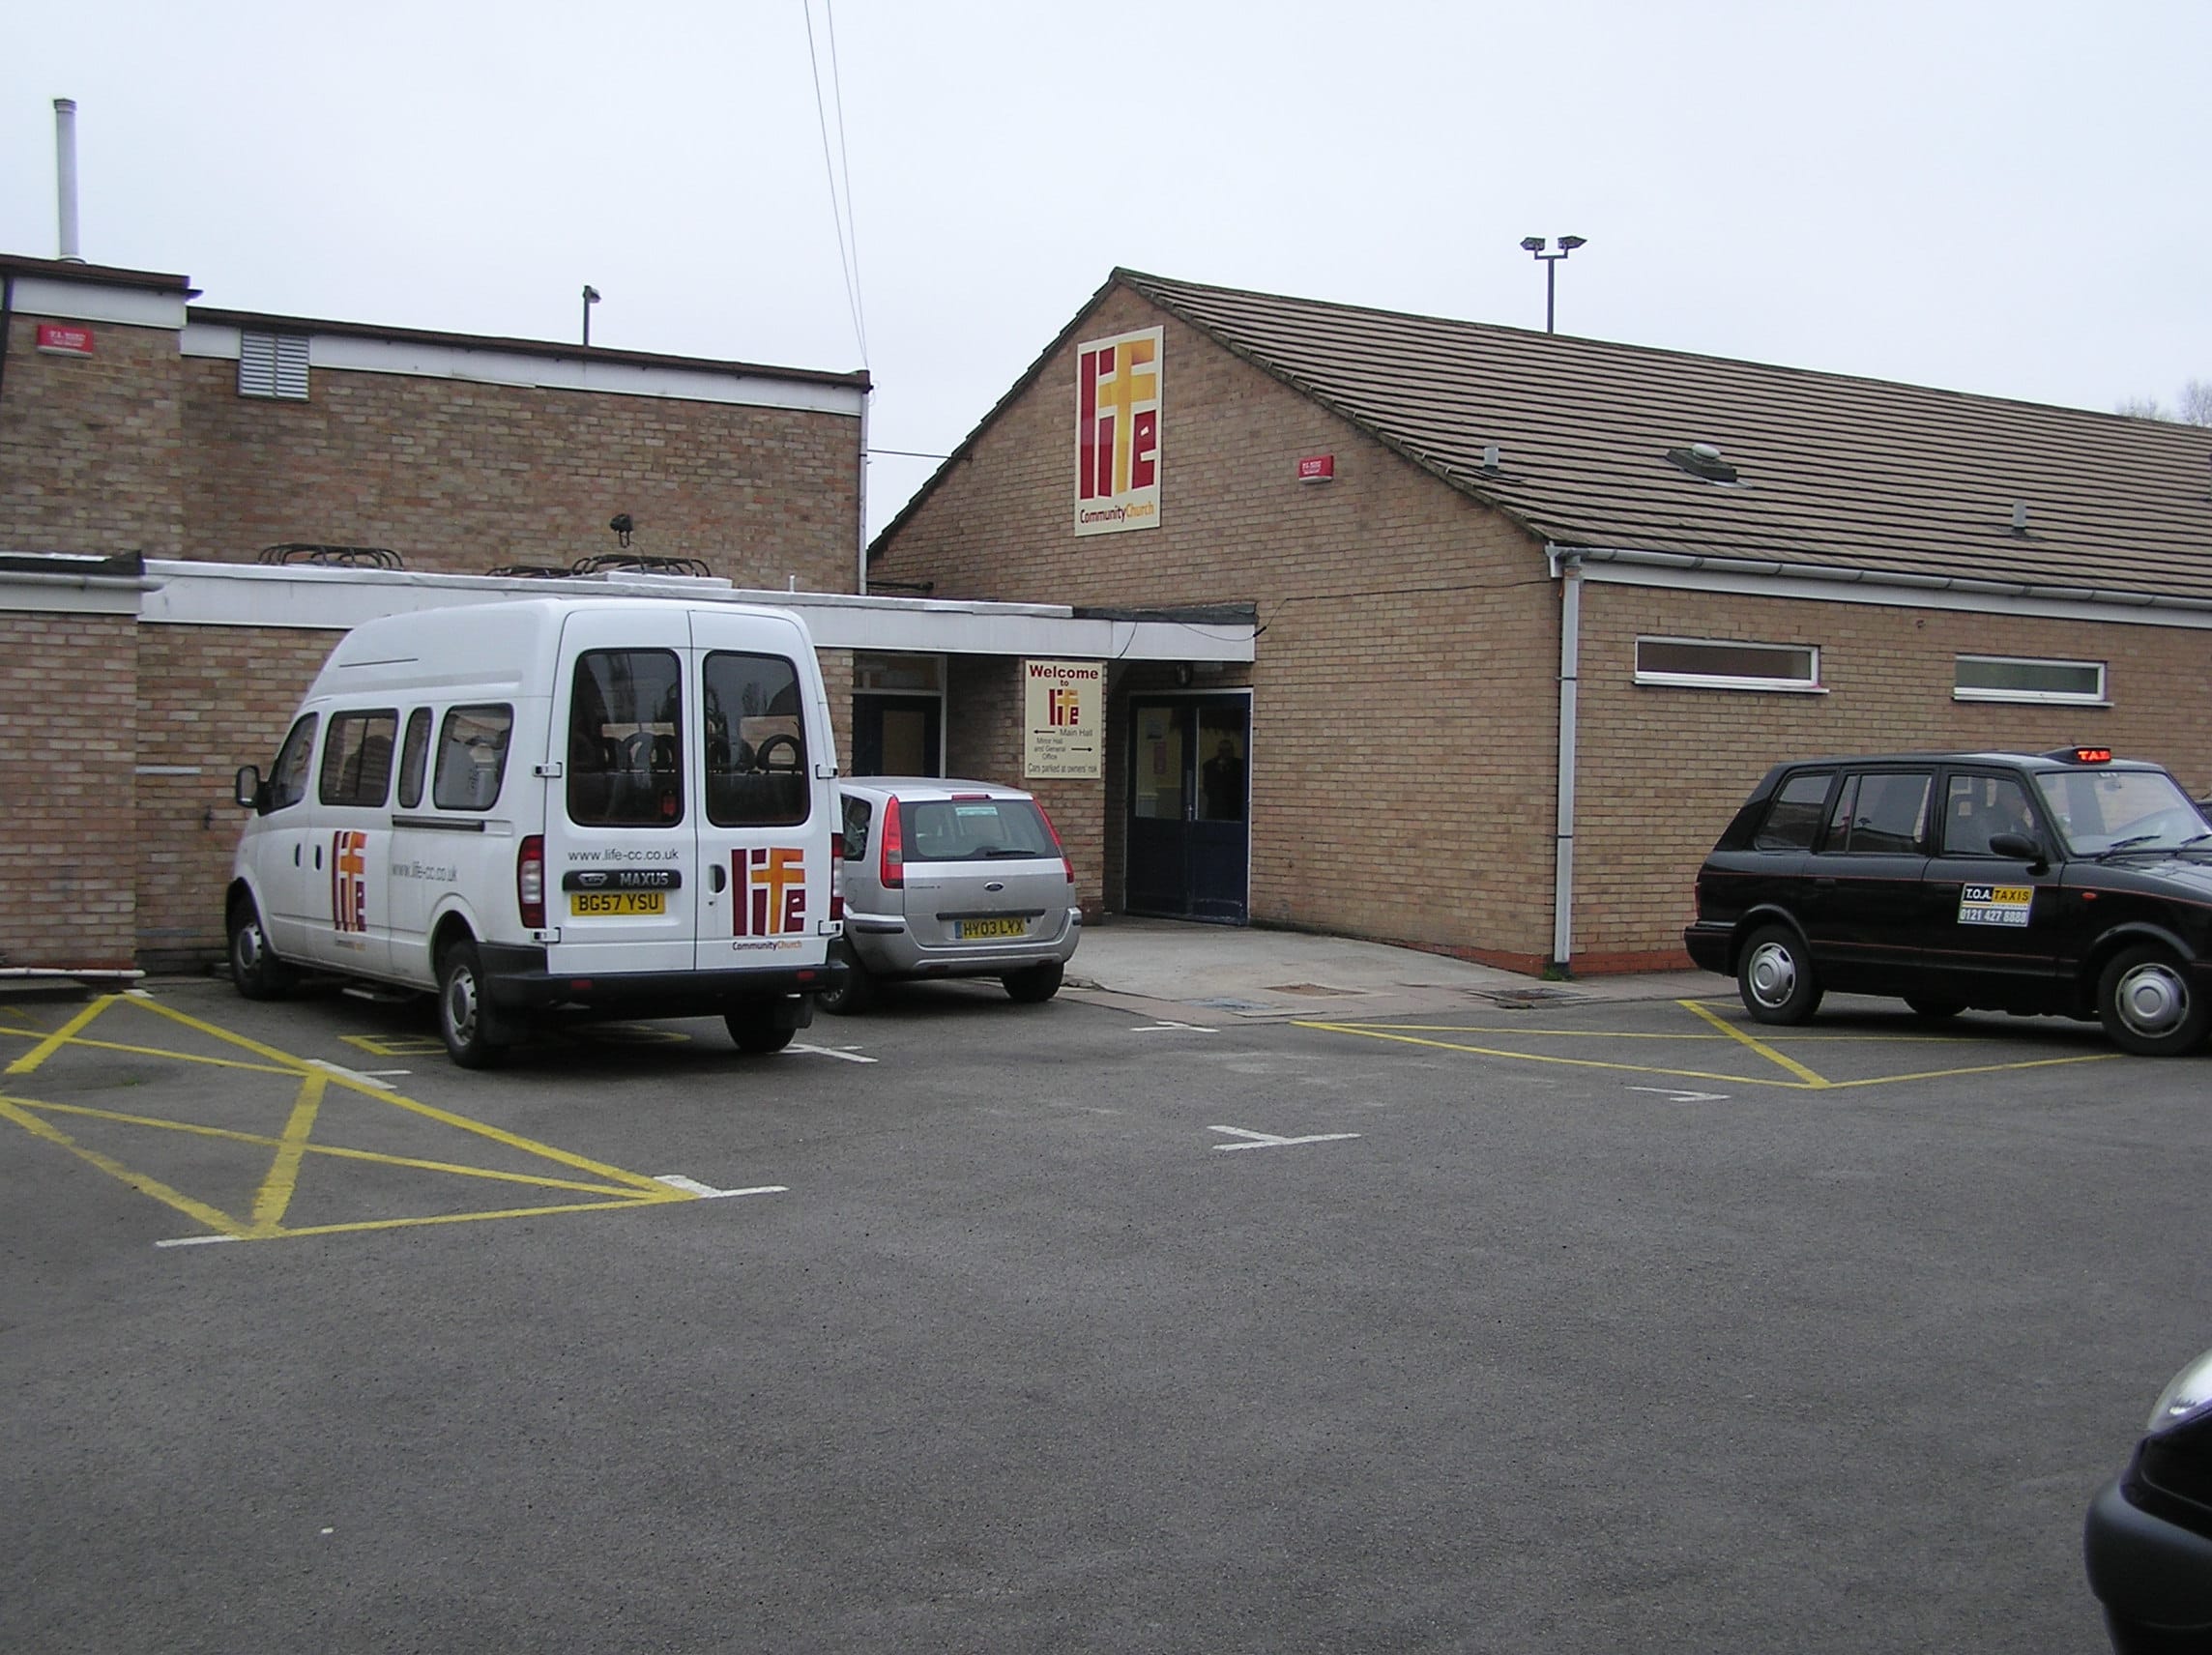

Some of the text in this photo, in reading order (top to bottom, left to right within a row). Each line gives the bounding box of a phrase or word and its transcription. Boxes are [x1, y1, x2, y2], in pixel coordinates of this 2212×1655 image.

[1029, 664, 1098, 679] Welcome
[568, 849, 680, 861] www.life-cc.co.uk
[620, 872, 669, 886] MAXUS
[578, 892, 658, 912] BG57 YSU
[1994, 889, 2029, 902] TAXIS
[1960, 909, 1982, 921] 0121
[1984, 910, 2003, 922] 427
[963, 919, 1024, 937] HY03 LYX
